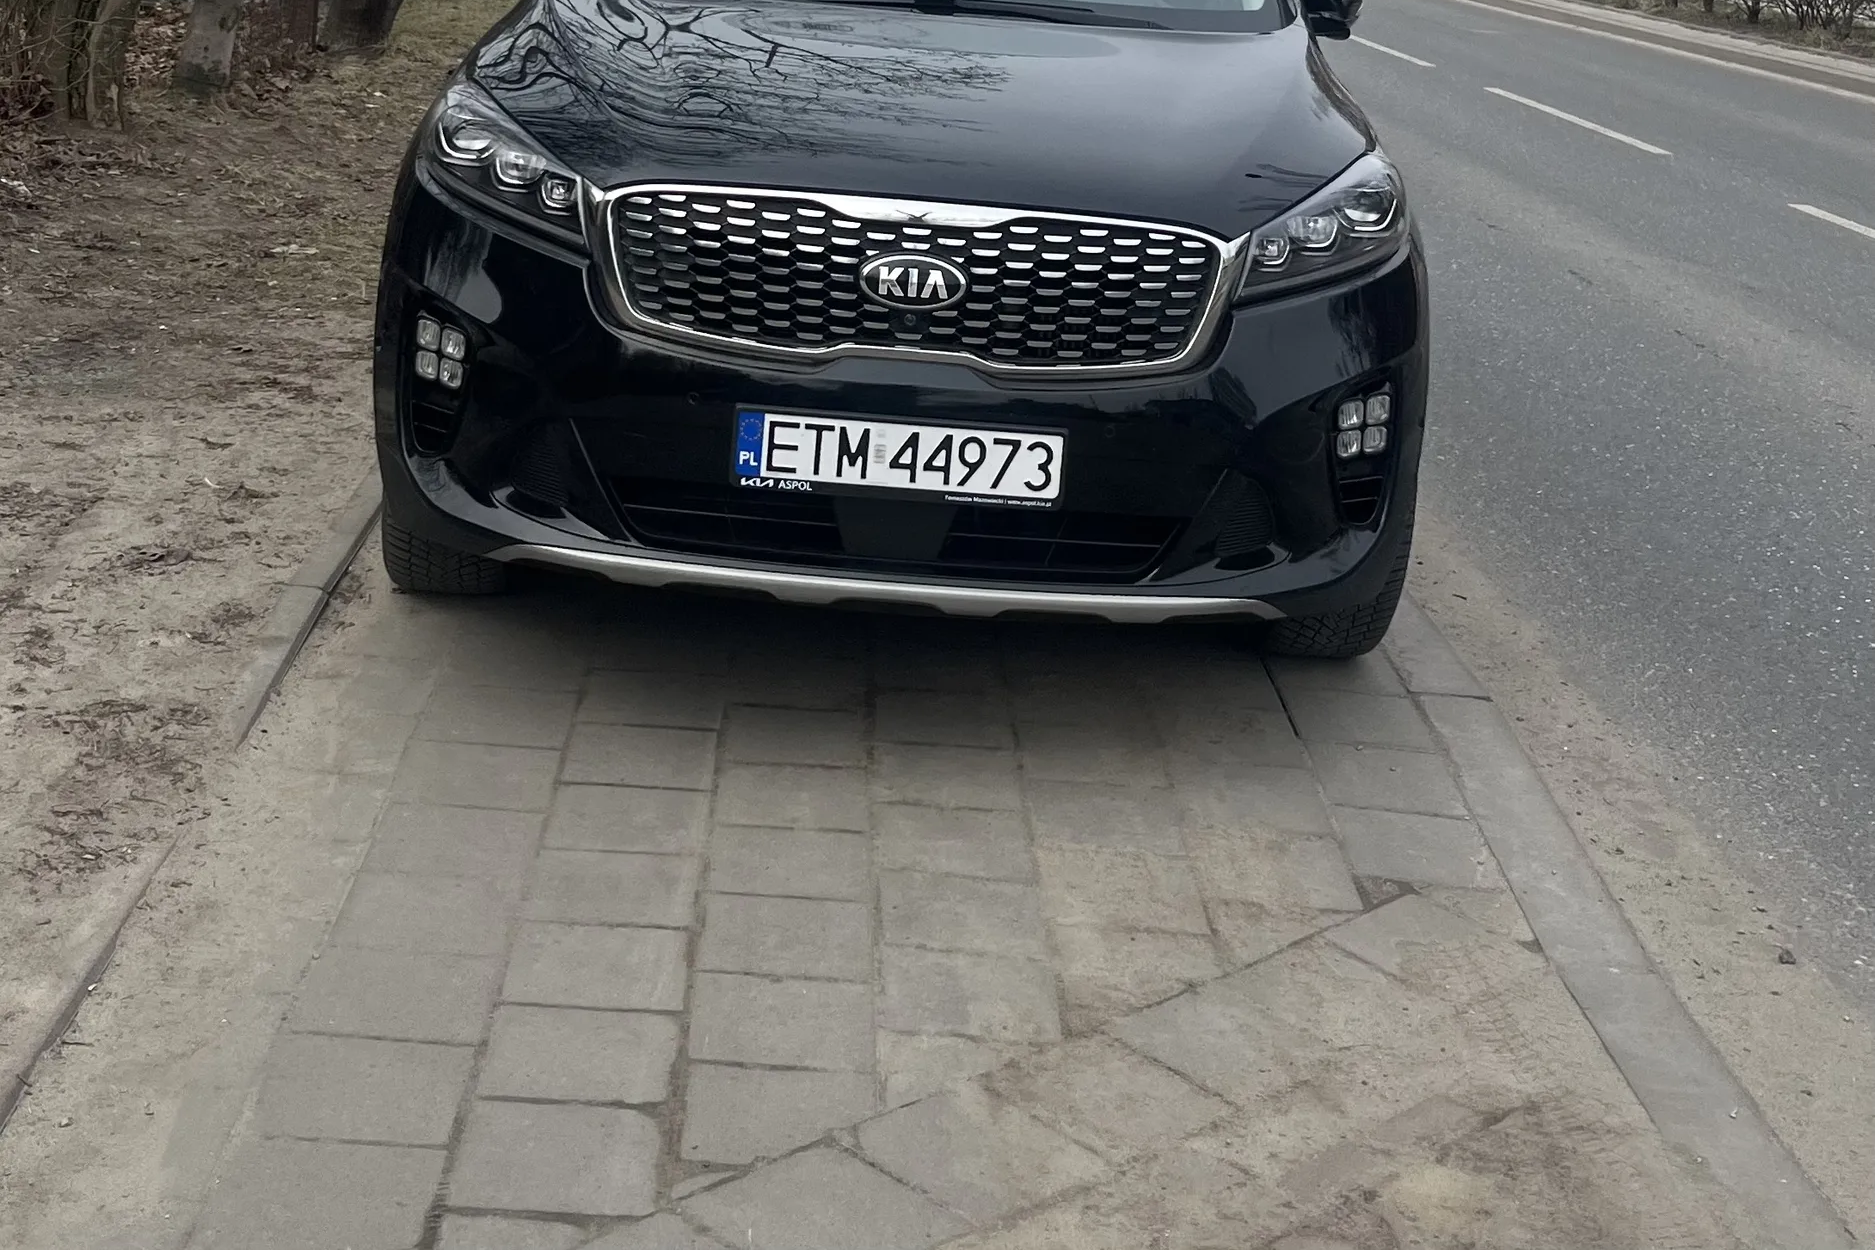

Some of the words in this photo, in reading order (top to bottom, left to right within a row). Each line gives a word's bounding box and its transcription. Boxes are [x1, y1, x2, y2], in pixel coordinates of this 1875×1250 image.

[878, 266, 948, 299] KIA
[739, 451, 758, 466] PL
[766, 420, 871, 479] ETM
[889, 431, 1054, 491] 44973
[778, 480, 812, 491] ASPOL
